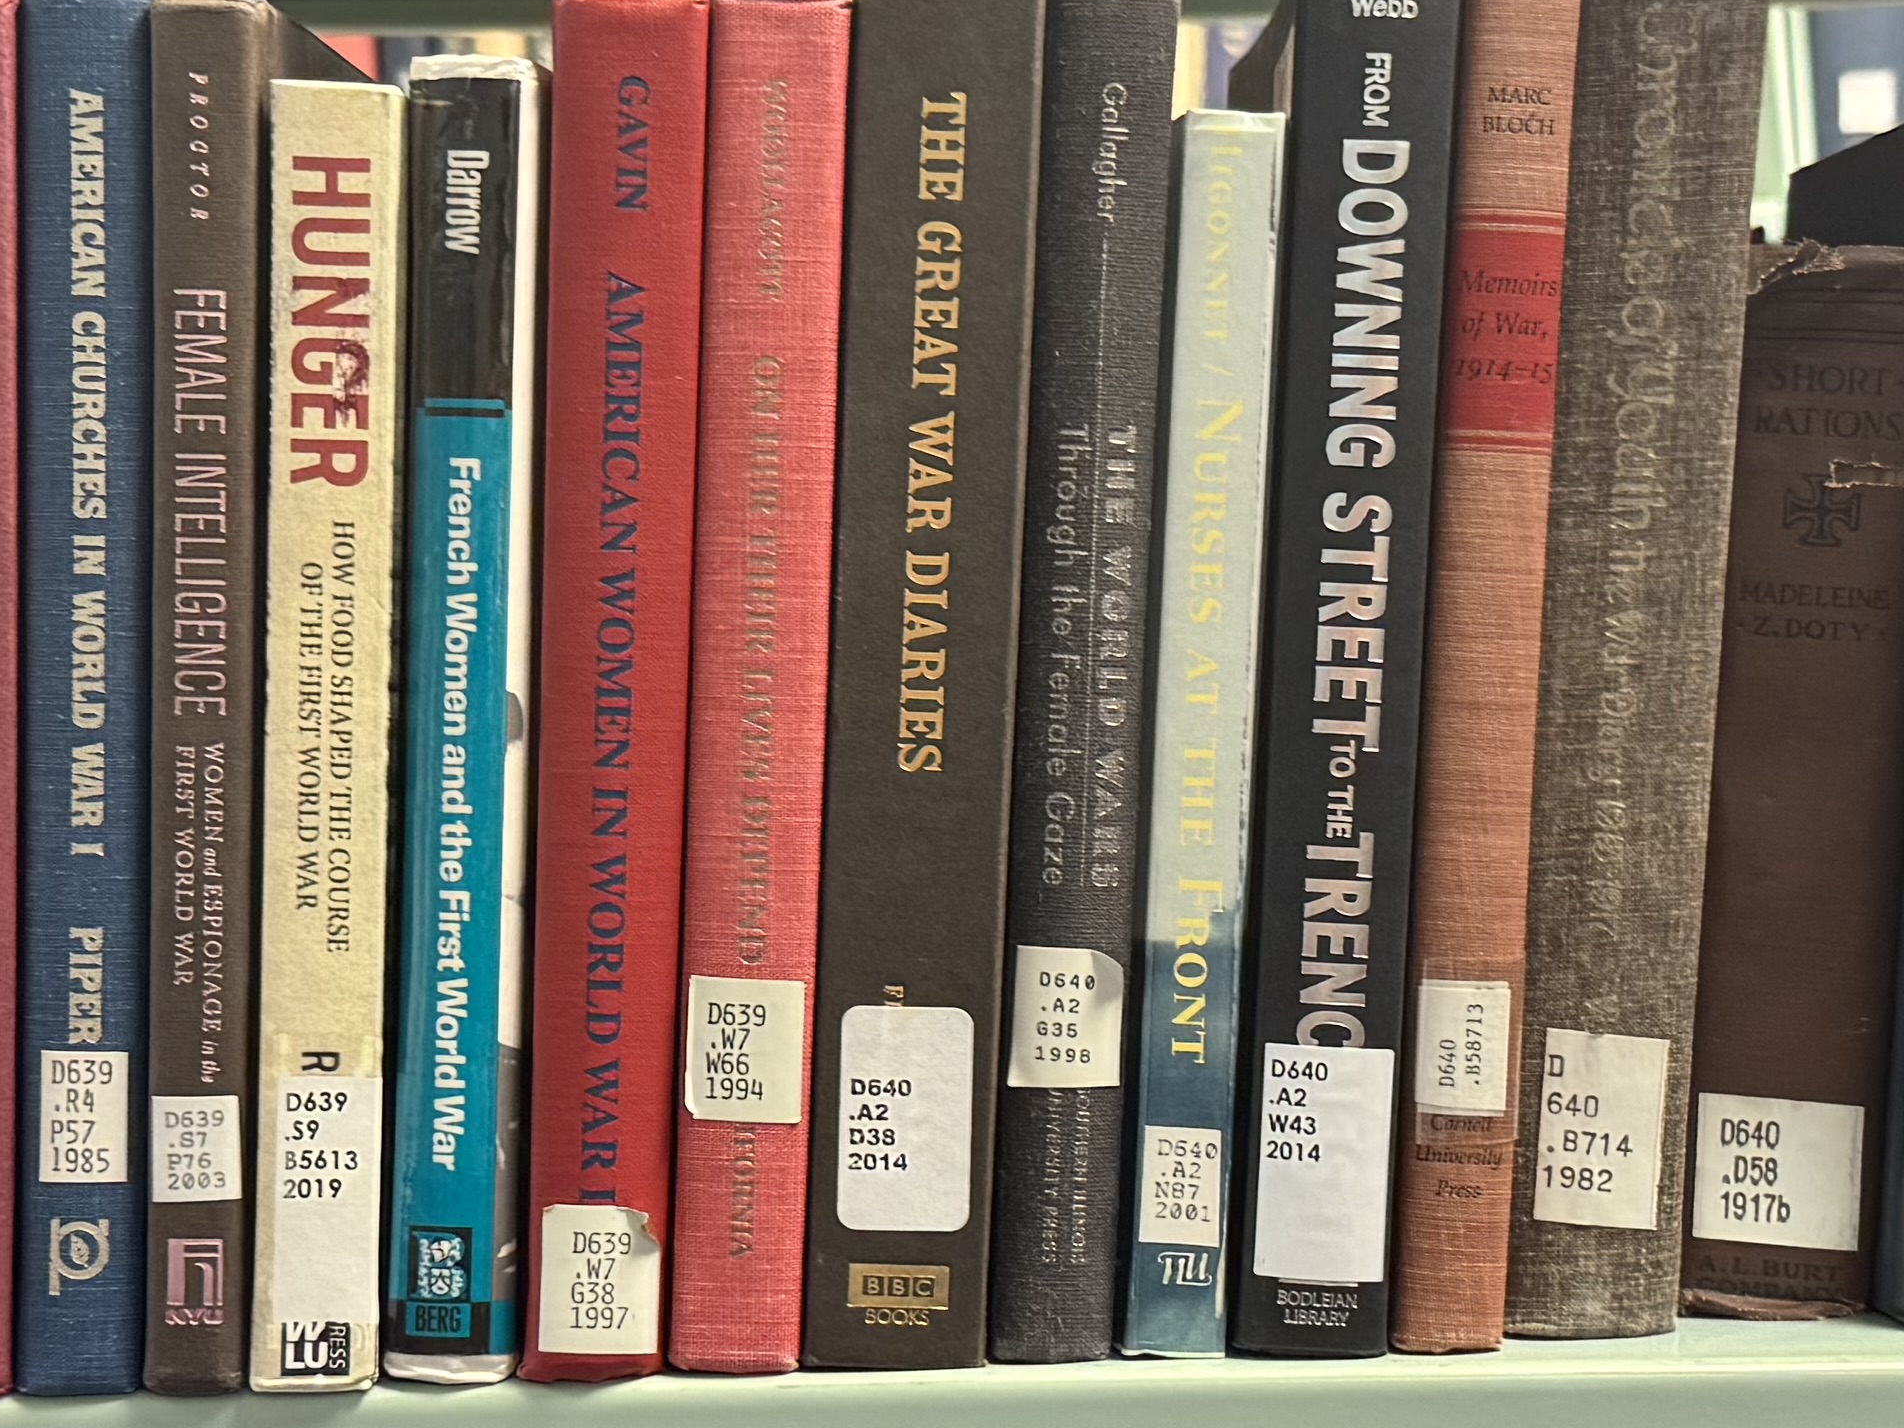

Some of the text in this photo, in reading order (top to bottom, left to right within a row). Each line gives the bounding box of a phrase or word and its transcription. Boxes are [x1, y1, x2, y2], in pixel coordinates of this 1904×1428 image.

[444, 149, 489, 255] Darrow
[1325, 52, 1409, 469] FROM DOWNING
[69, 90, 107, 520] AMERICAN CHURCHES
[290, 155, 371, 488] HUNGER
[599, 75, 651, 555] GAVIN AMERICAN
[906, 91, 967, 534] THE GREAT WAR
[68, 927, 104, 1044] PIPER
[432, 744, 473, 1171] and the First World War
[284, 1120, 319, 1141] .S9
[285, 1092, 348, 1112] D639
[285, 1150, 358, 1171] B5613
[283, 1179, 342, 1199] 2019
[415, 1306, 462, 1333] BERG
